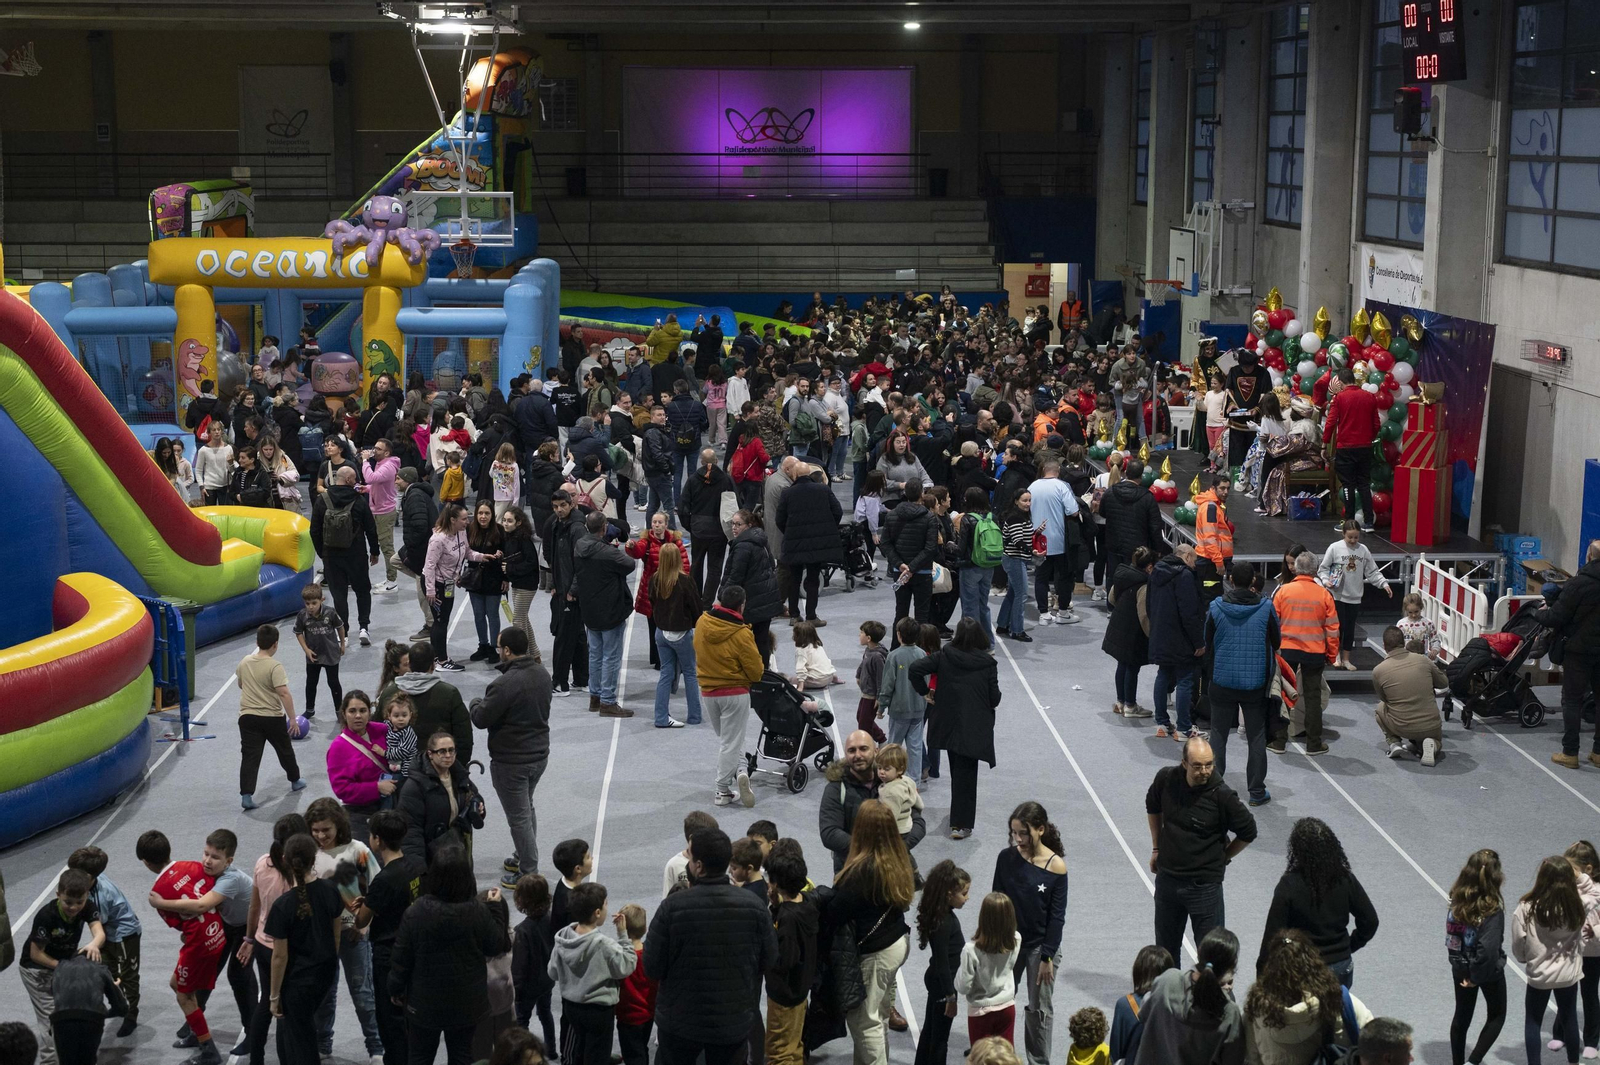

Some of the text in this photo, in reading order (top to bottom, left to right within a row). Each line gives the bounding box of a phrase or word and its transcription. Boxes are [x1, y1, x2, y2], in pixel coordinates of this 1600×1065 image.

[1404, 4, 1417, 28] 00
[1403, 36, 1418, 48] LOCAL
[1416, 54, 1437, 79] 00:0
